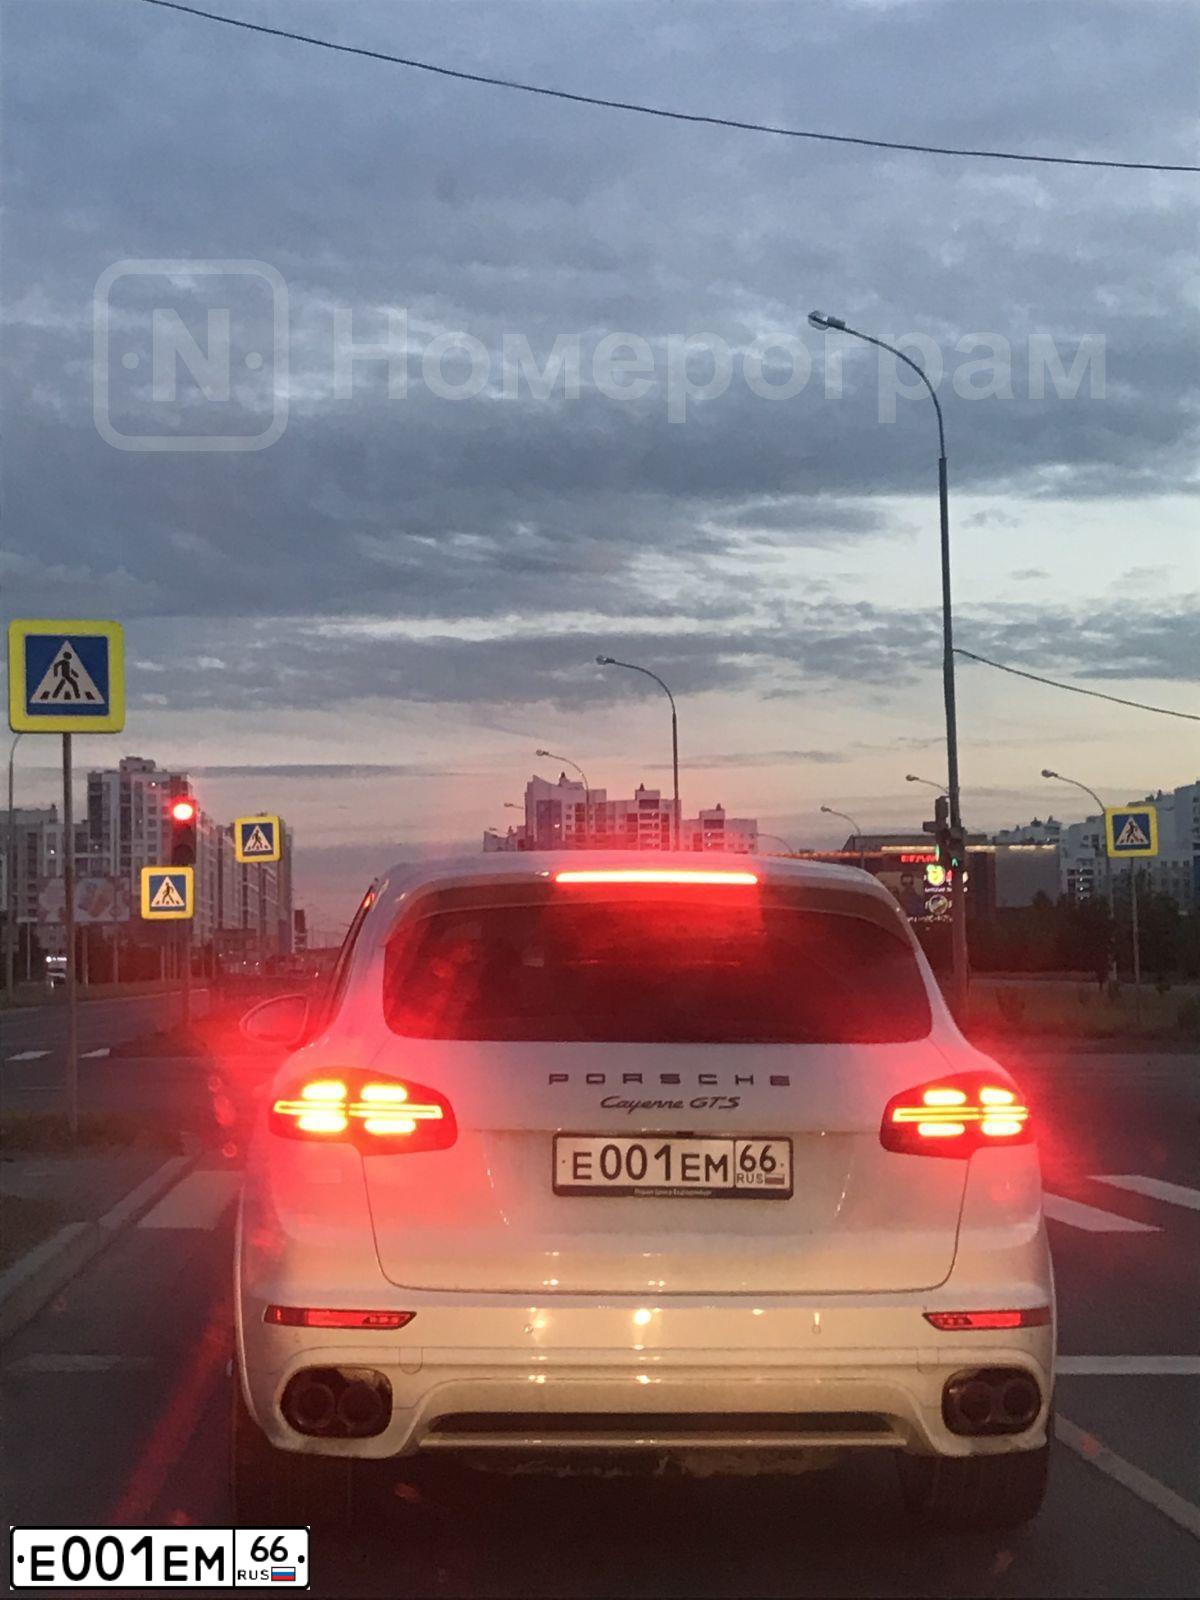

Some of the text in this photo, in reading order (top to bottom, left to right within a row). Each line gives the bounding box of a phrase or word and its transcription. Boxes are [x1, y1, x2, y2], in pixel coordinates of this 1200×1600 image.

[549, 1073, 790, 1086] PORSCHE
[600, 1095, 741, 1114] Cayenne GTS
[739, 1144, 777, 1173] 66
[736, 1173, 764, 1185] RUS
